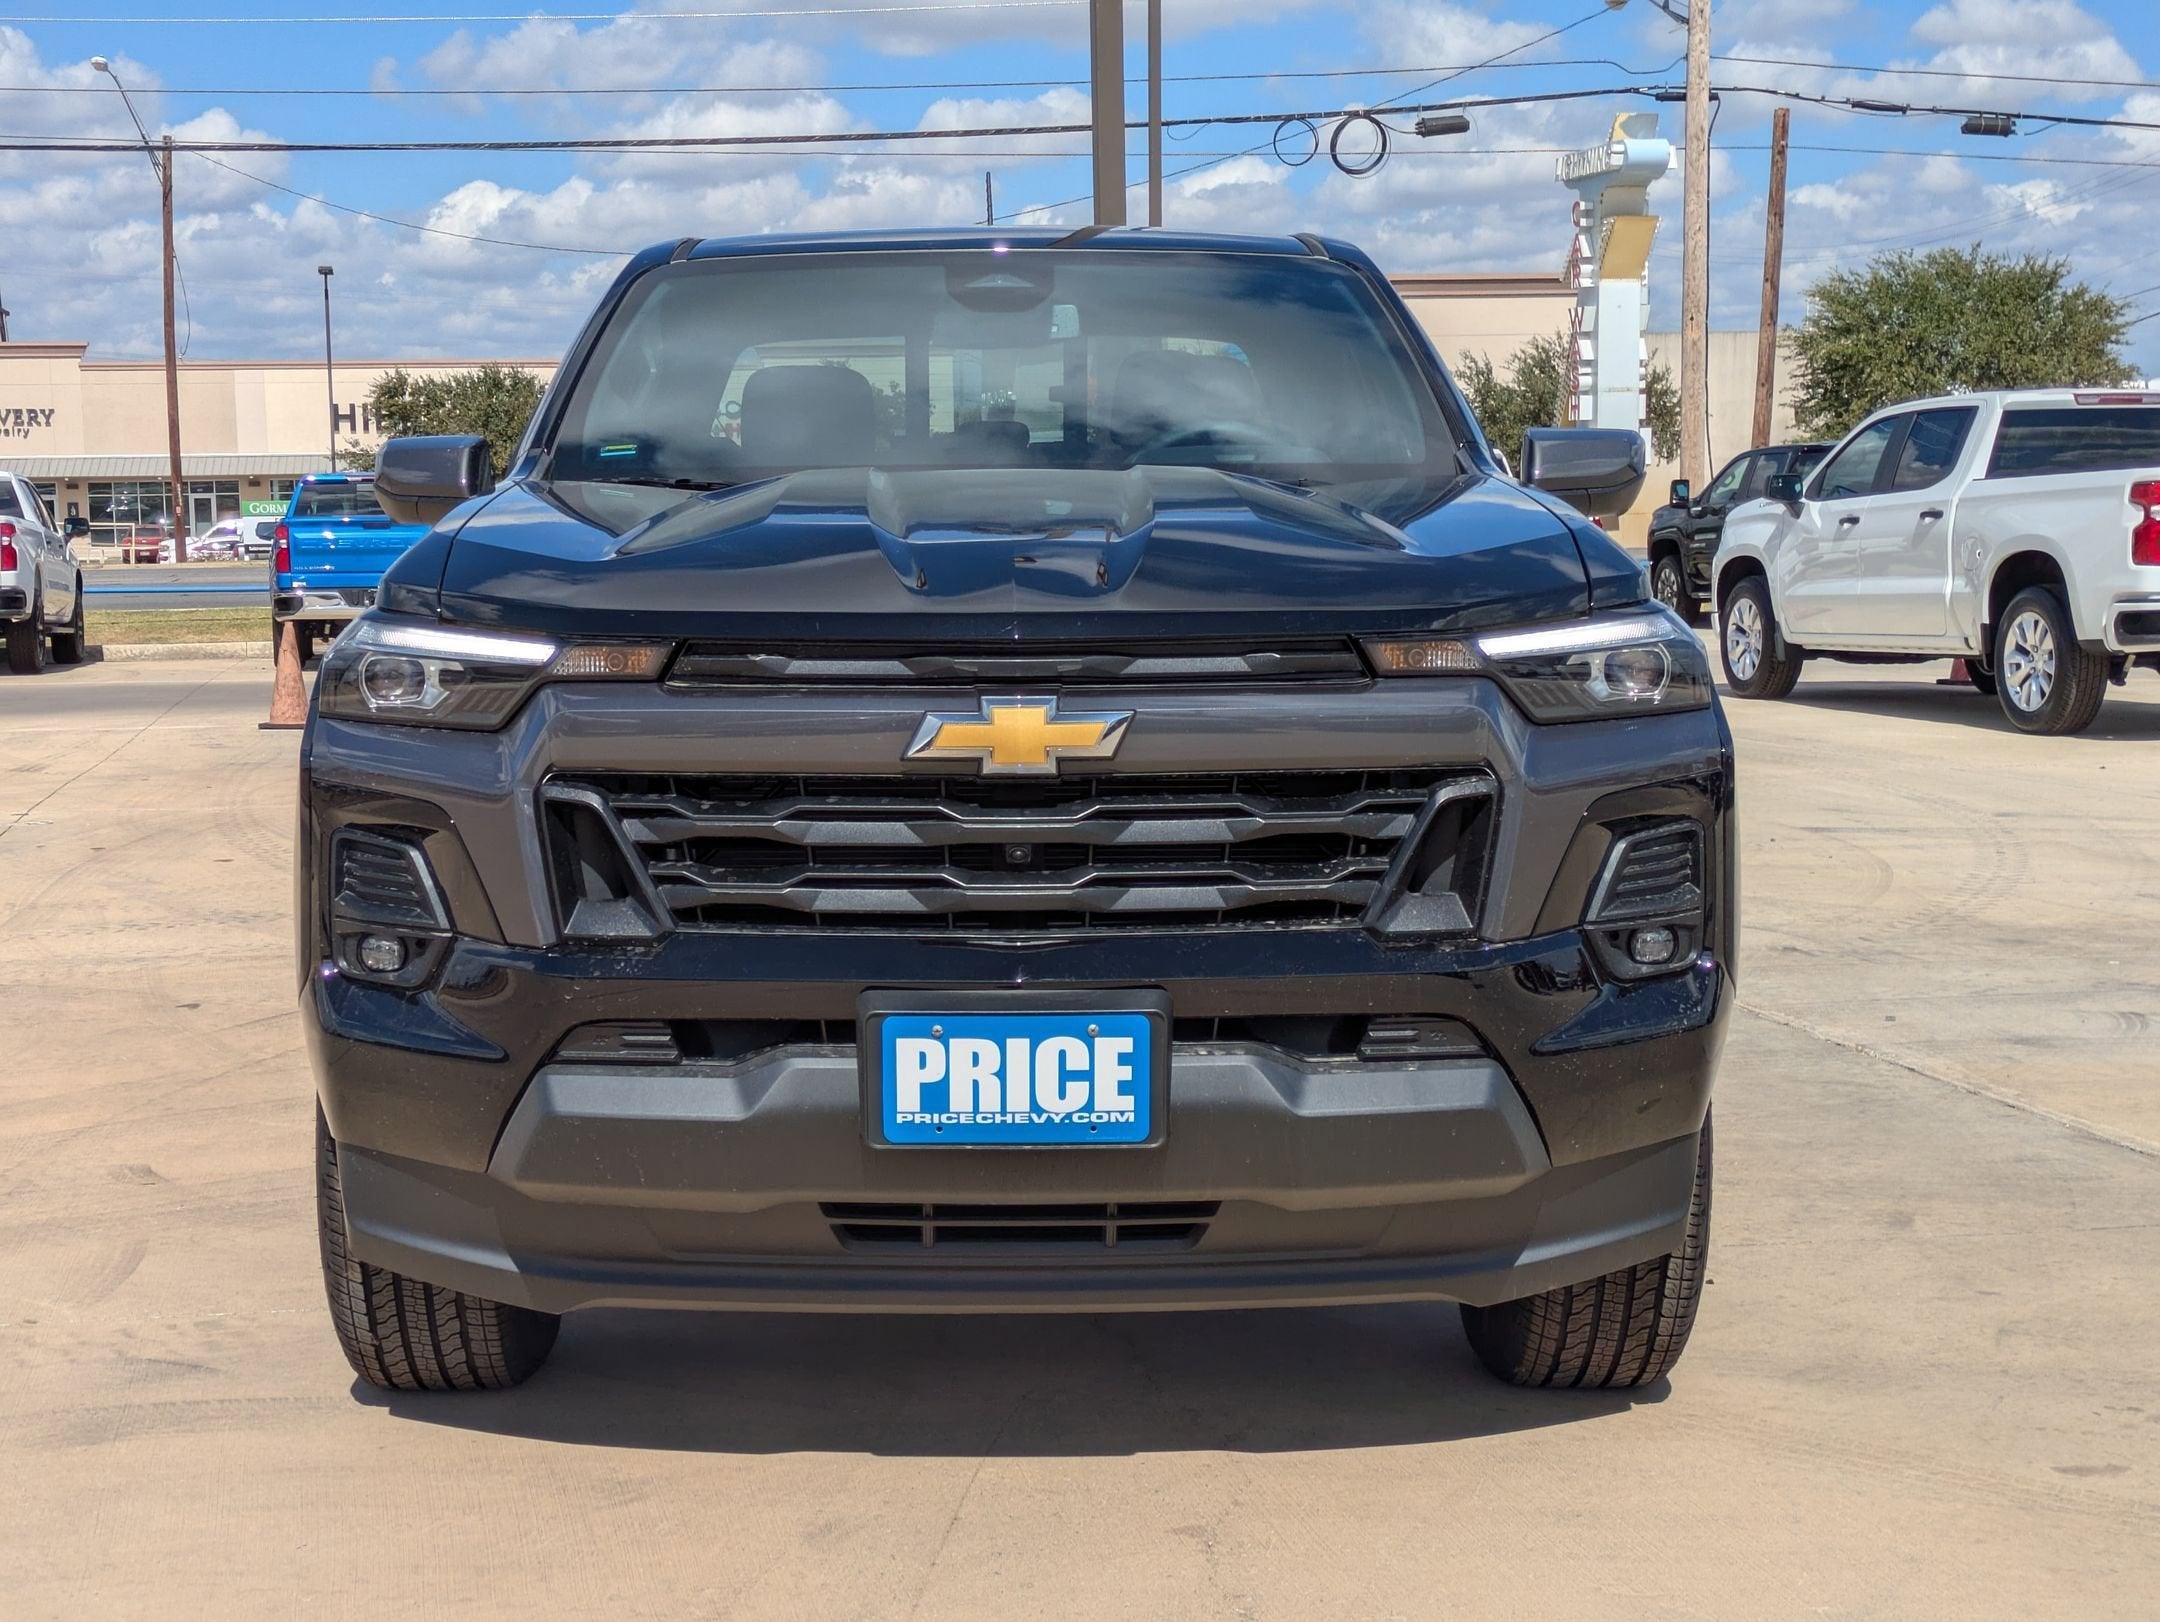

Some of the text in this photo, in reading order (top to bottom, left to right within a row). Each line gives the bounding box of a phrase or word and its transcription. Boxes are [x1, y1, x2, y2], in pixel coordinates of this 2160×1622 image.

[1568, 200, 1586, 421] CAR WASH
[0, 426, 30, 439] elry
[896, 1036, 1135, 1113] PRICE
[896, 1112, 1135, 1124] PRICECHEVY.COM
